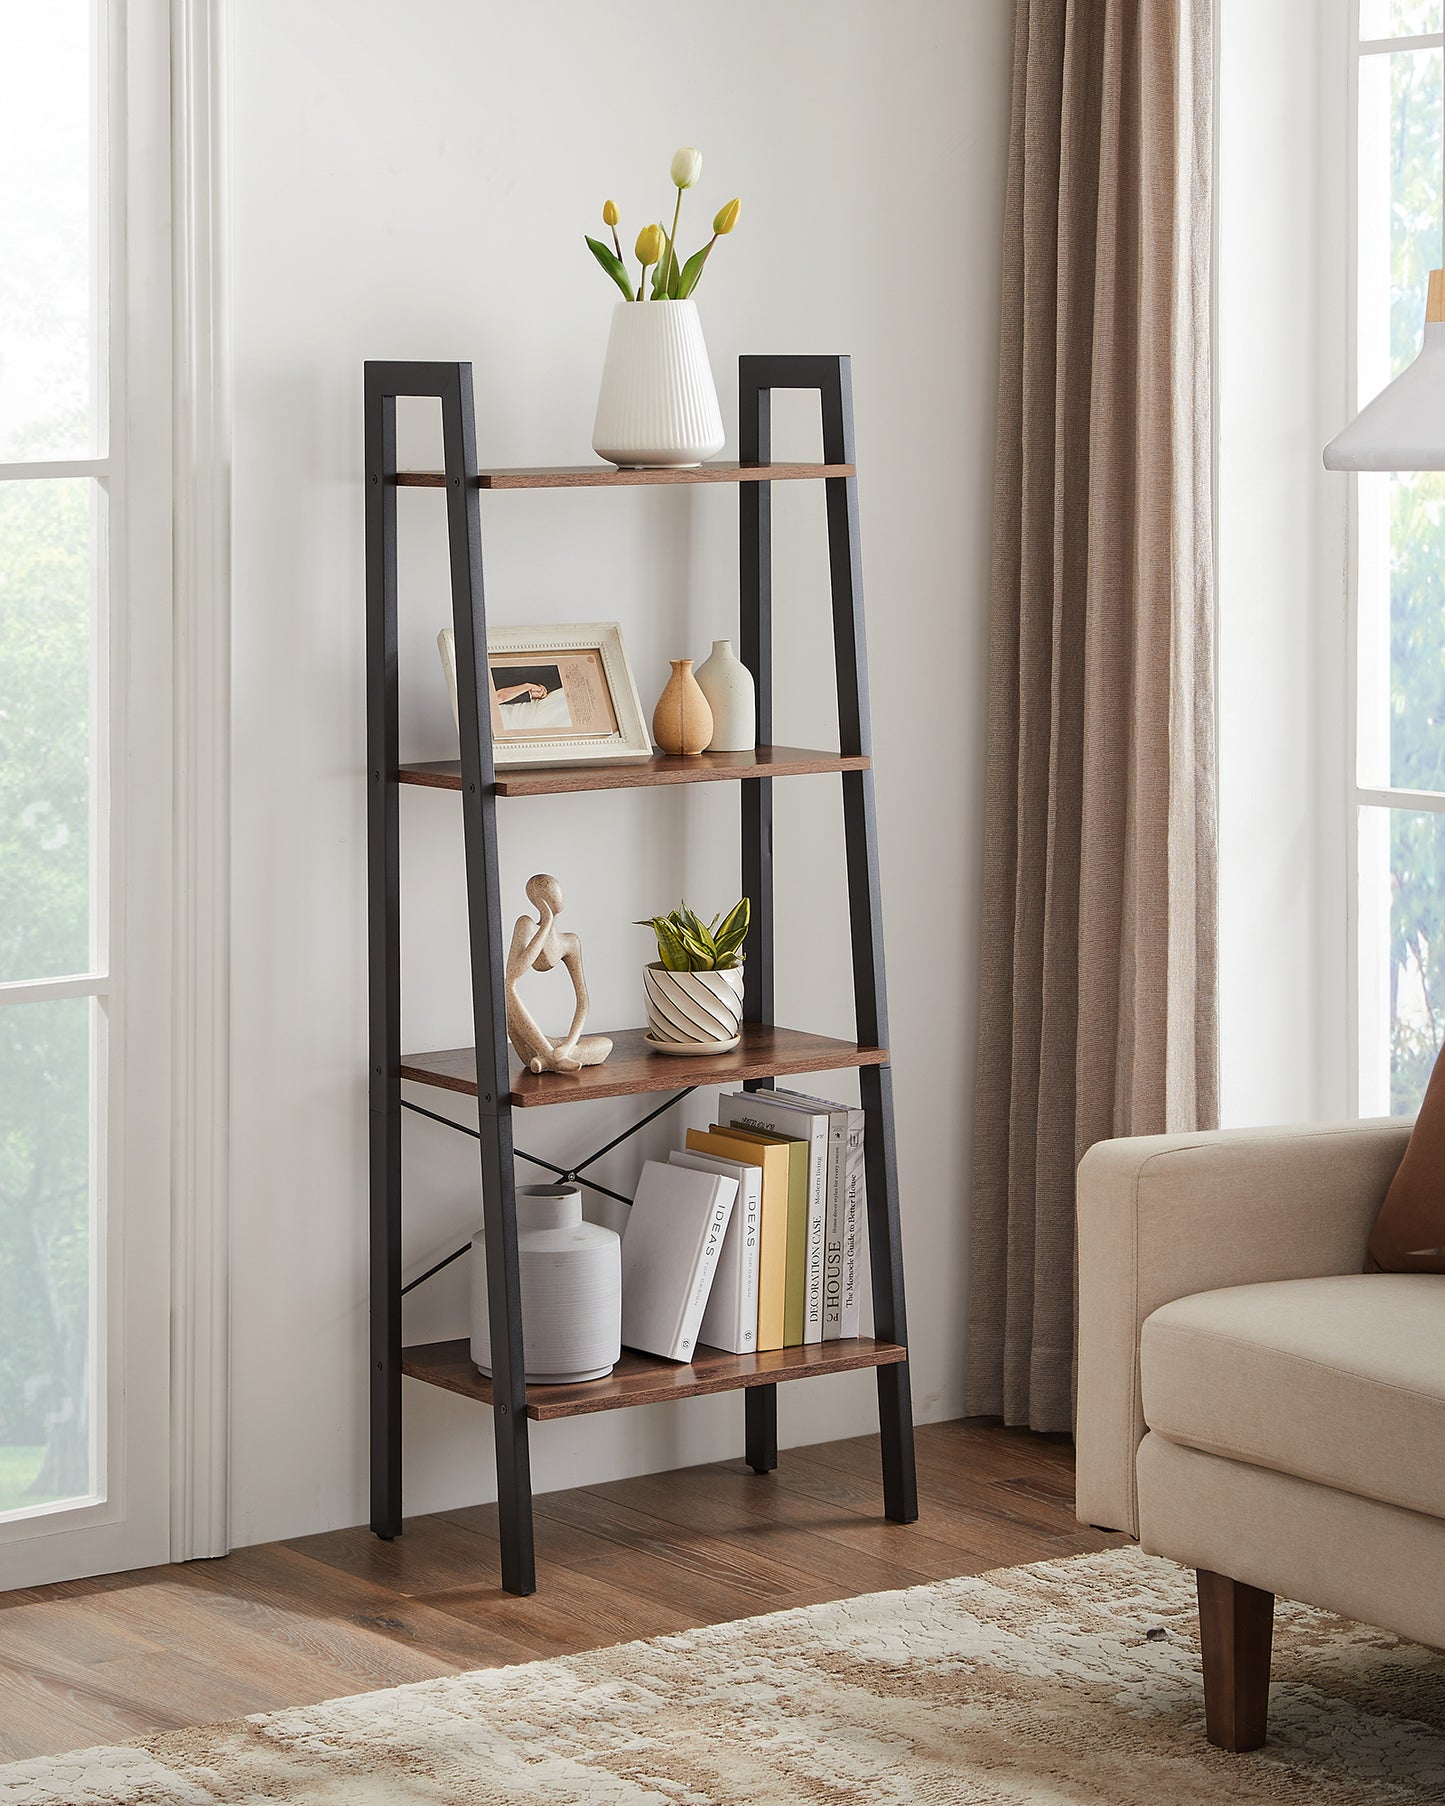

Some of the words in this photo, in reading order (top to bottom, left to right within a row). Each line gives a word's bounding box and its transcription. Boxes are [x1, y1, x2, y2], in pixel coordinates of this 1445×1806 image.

[849, 1174, 857, 1198] House
[746, 1195, 756, 1247] IDEAS
[848, 1199, 856, 1223] Better
[705, 1205, 726, 1256] IDEAS
[812, 1216, 821, 1245] CASE
[848, 1223, 855, 1233] to
[847, 1234, 855, 1257] Guide
[810, 1247, 820, 1322] DECORATION
[827, 1241, 841, 1309] HOUSE
[846, 1258, 854, 1291] Monocle
[694, 1278, 705, 1306] DESIGN
[846, 1292, 854, 1308] The
